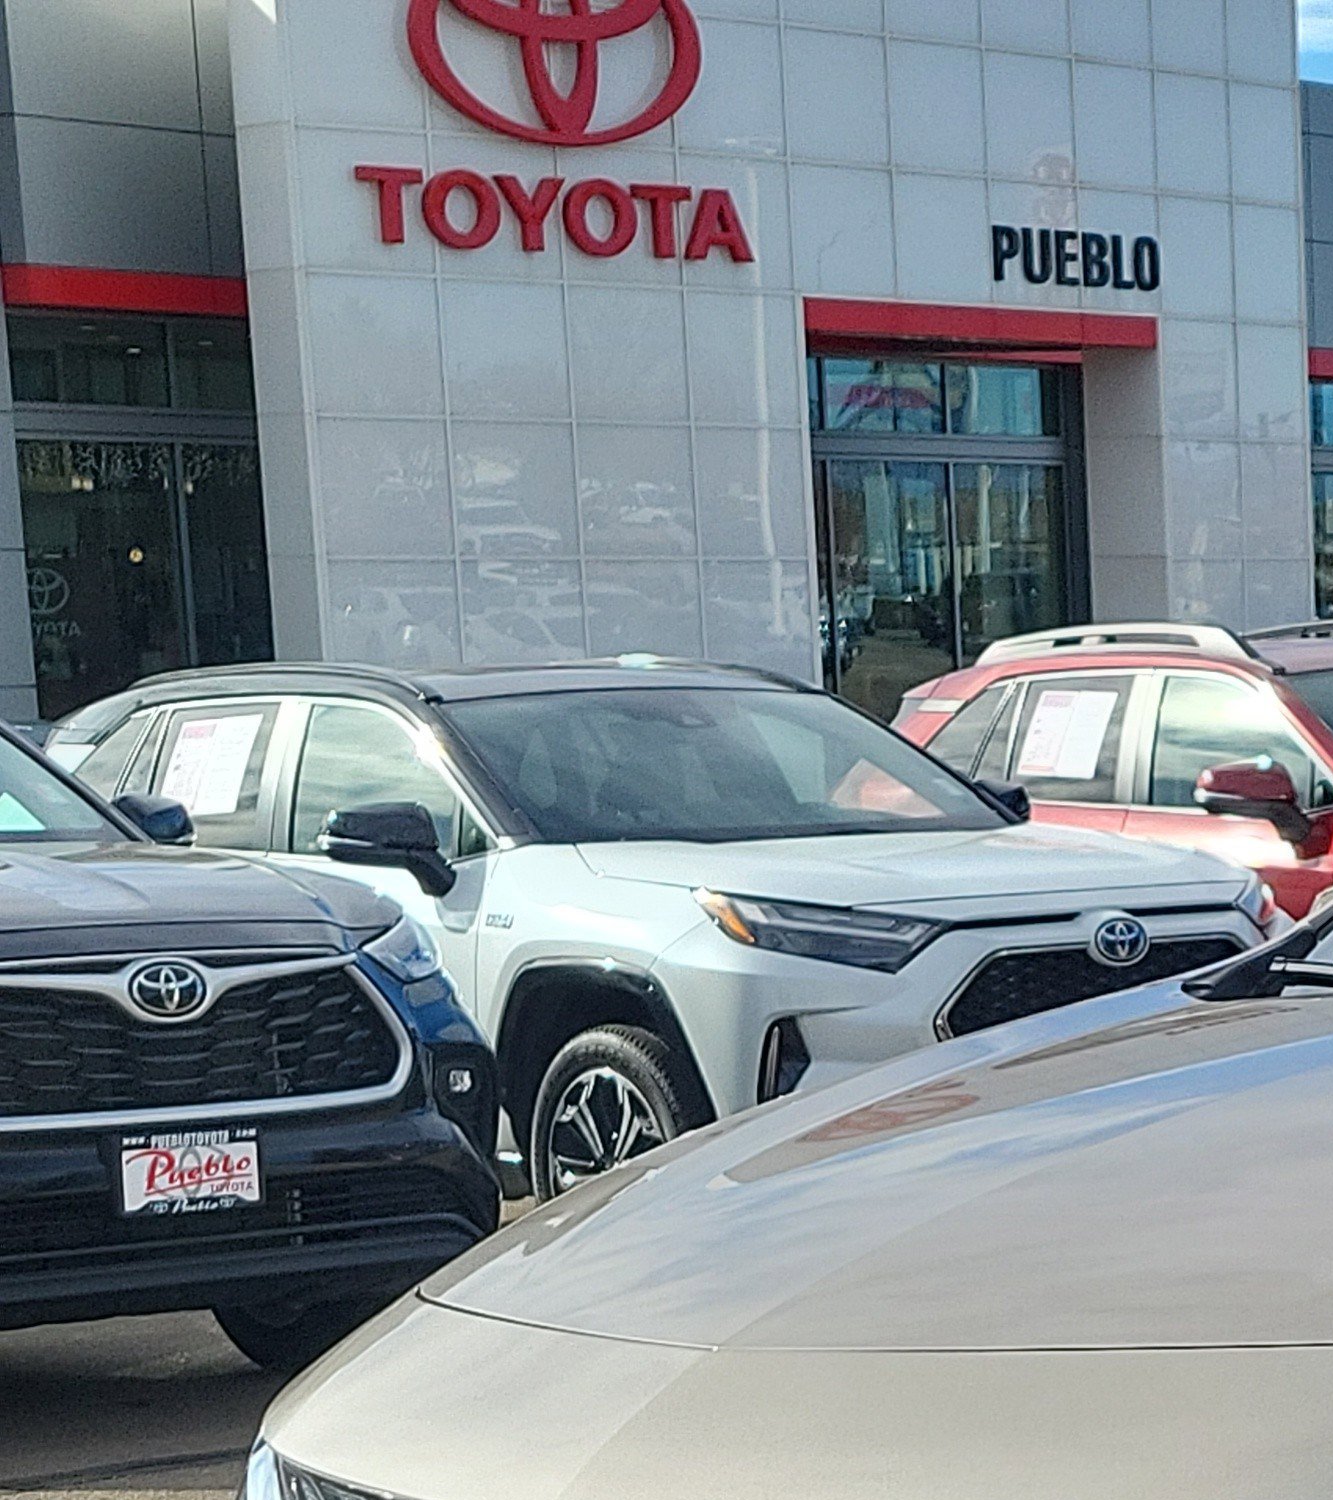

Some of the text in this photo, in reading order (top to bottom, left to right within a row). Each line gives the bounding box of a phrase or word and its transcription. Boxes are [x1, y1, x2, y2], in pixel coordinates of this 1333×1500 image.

[354, 164, 755, 263] TOYOTA
[991, 224, 1160, 291] PUEBLO
[125, 1150, 251, 1192] Pueblo
[211, 1182, 254, 1193] TOYOTA
